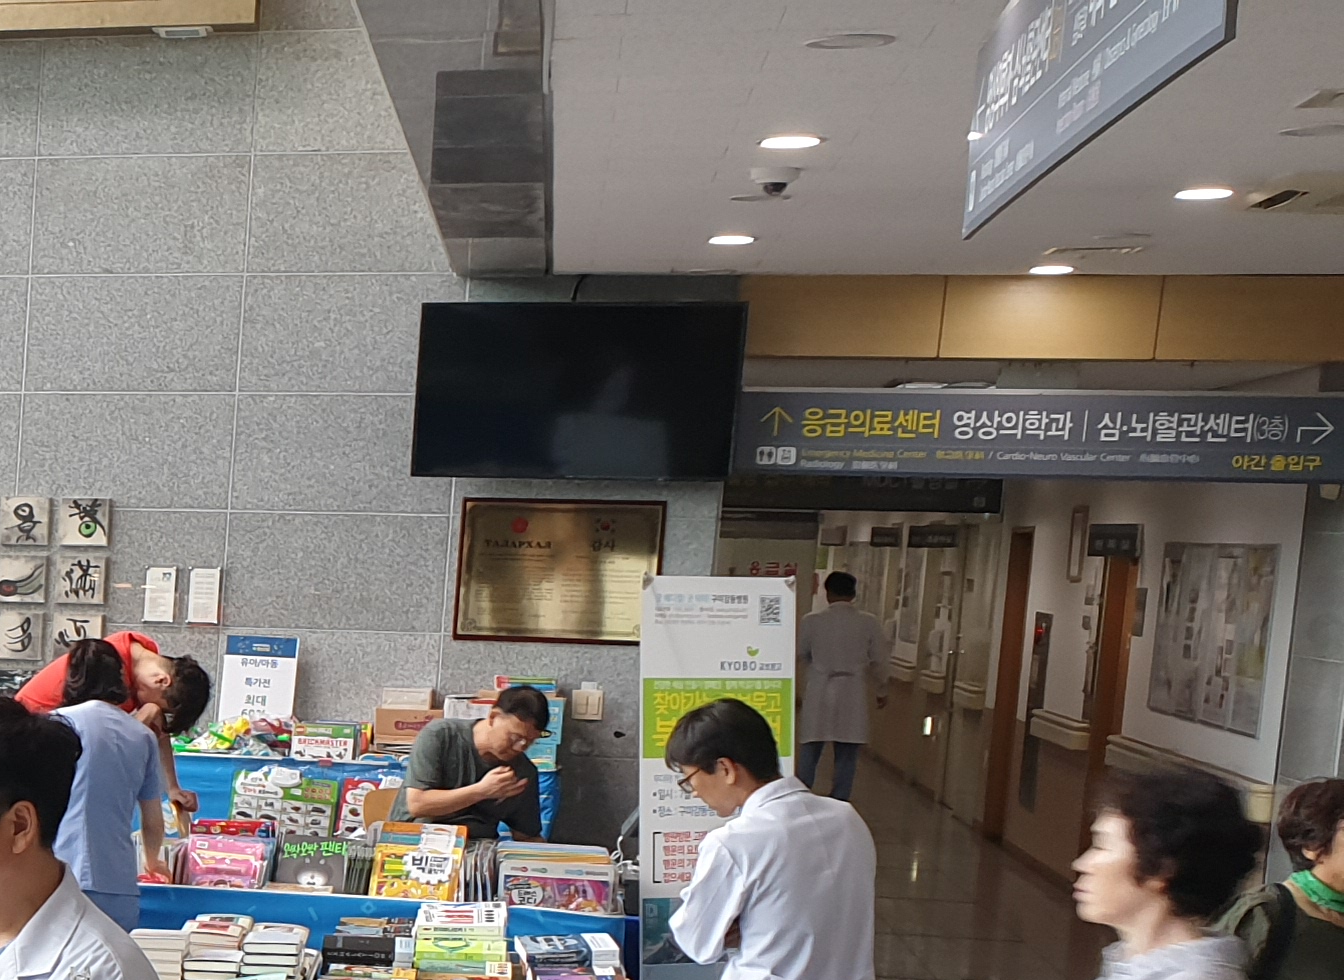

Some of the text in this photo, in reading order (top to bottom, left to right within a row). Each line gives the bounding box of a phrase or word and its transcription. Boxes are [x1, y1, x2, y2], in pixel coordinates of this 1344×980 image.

[801, 408, 942, 440] 응급의료센터
[952, 410, 1073, 442] 영상의학과
[1060, 452, 1097, 461] Vascular
[1100, 453, 1131, 462] Center
[1231, 454, 1322, 471] 야간 출입구
[800, 459, 846, 470] Radiology
[720, 660, 757, 671] KYOBO
[411, 855, 429, 874] 빅
